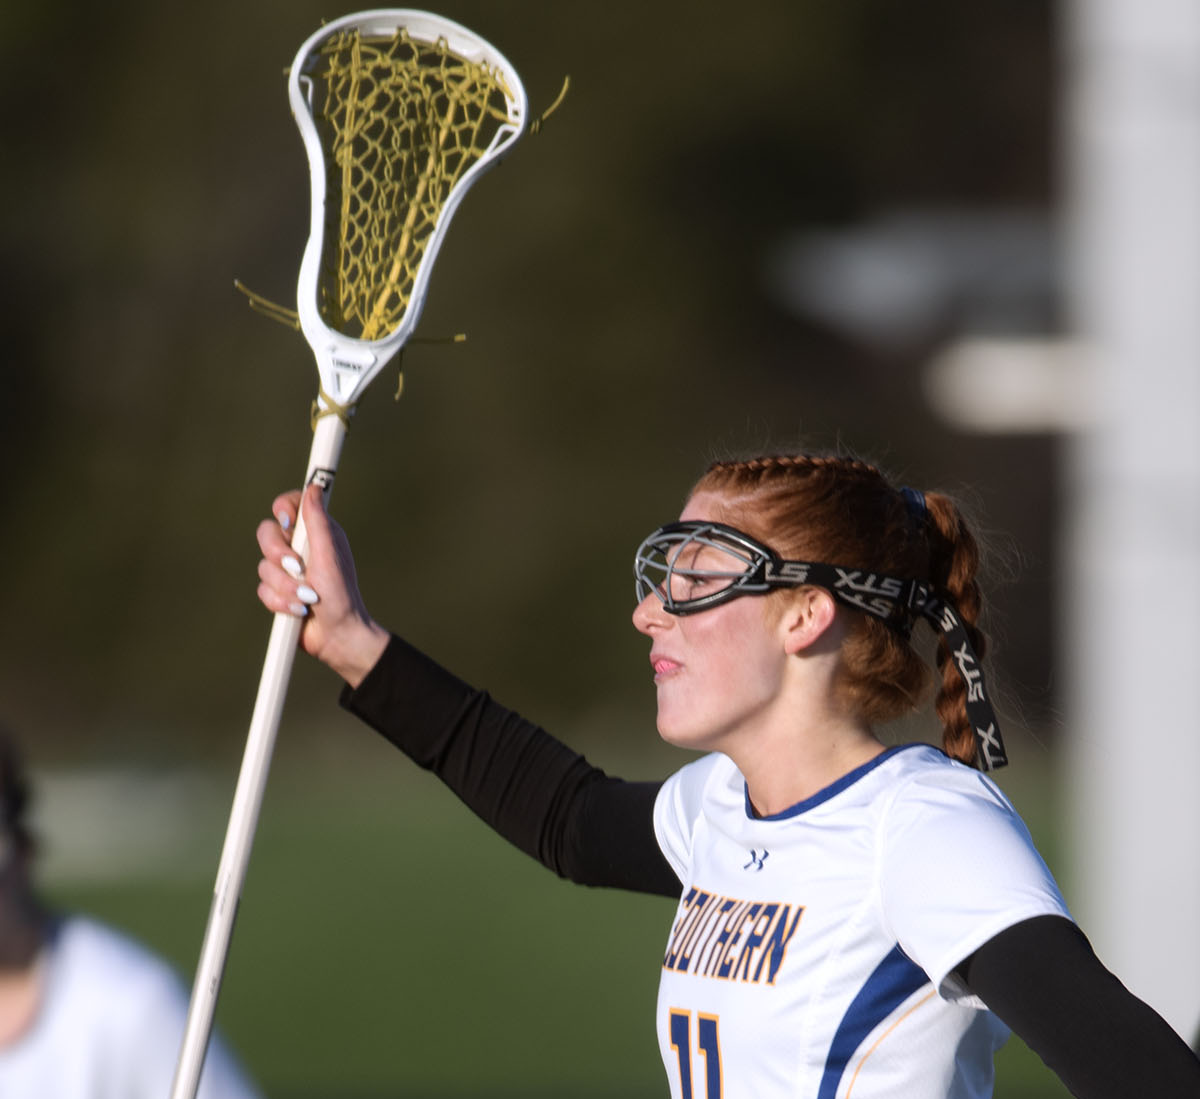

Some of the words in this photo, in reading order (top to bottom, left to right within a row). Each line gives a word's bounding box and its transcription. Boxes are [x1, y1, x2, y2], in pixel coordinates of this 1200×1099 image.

[764, 561, 811, 584] ST
[833, 568, 903, 599] STX
[836, 589, 893, 619] ST
